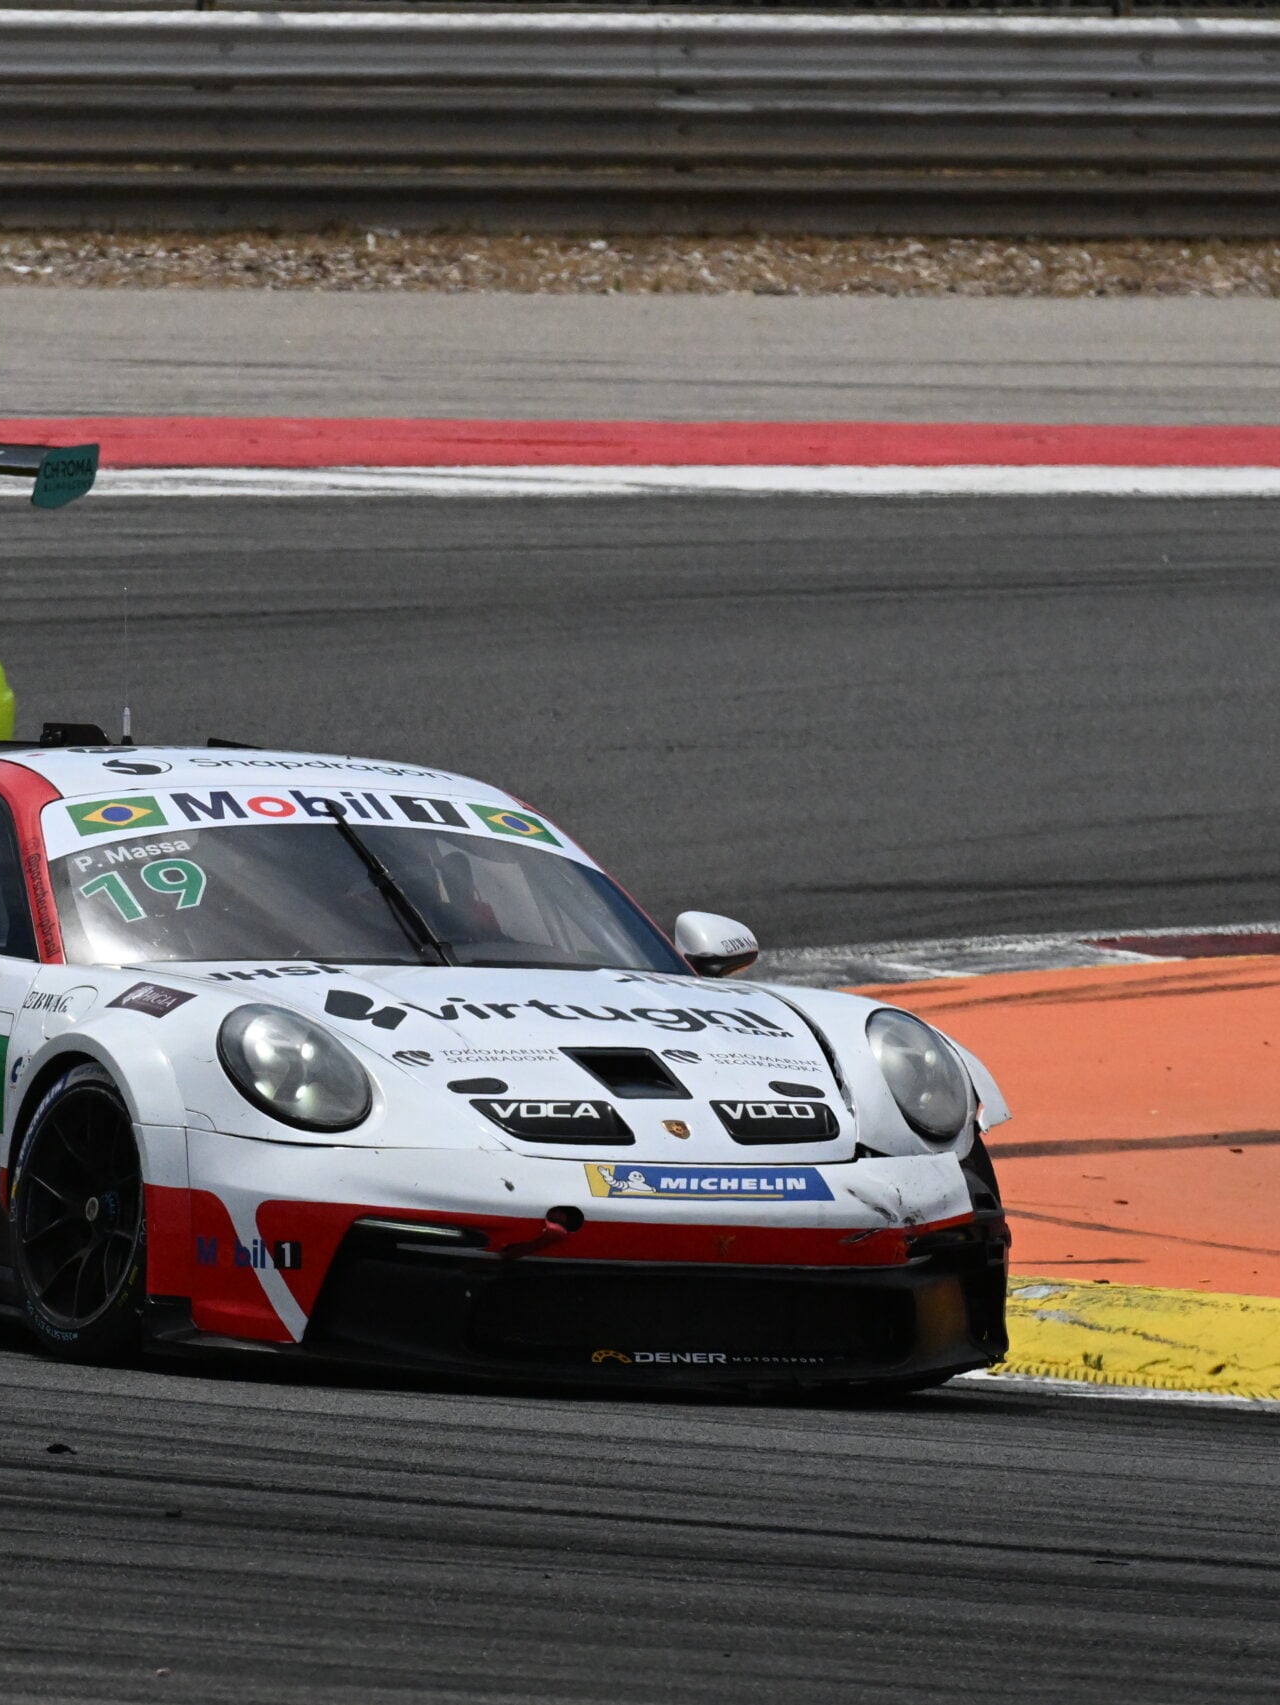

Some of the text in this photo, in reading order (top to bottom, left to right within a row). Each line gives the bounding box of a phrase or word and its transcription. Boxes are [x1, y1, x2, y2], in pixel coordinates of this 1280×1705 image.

[43, 458, 93, 479] CHROMA
[188, 758, 454, 781] Snapdragon
[169, 789, 394, 823] Mobil
[74, 837, 192, 874] P. Massa
[78, 857, 208, 924] 19
[25, 850, 61, 959] @porschecupbrasil
[715, 1025, 795, 1038] TEAM
[439, 1048, 559, 1057] TOKIO MARINE
[446, 1055, 560, 1064] SEGURADORA
[758, 1055, 822, 1066] MARINE
[714, 1059, 824, 1073] SEGURADORA
[490, 1102, 601, 1120] VOCA
[721, 1102, 817, 1121] VOCO
[659, 1176, 807, 1191] MICHELIN
[632, 1351, 825, 1364] DENER MOTORSPORT
